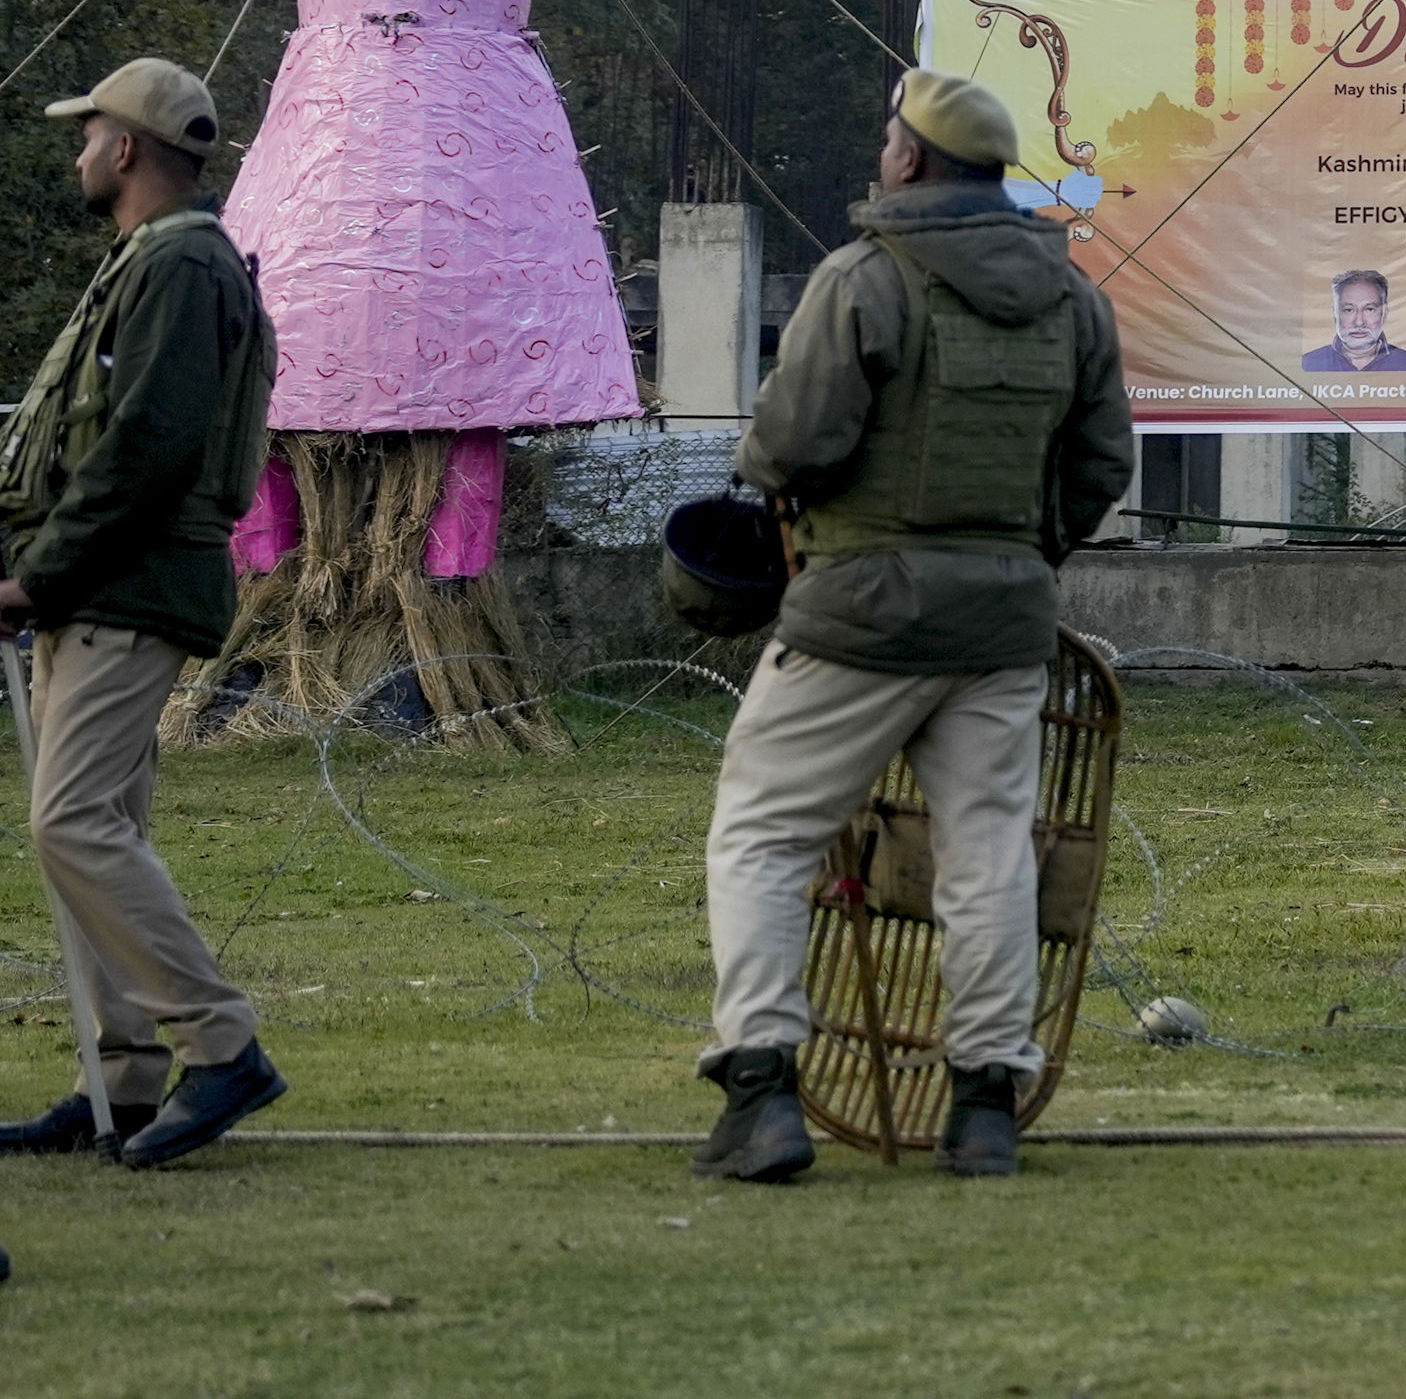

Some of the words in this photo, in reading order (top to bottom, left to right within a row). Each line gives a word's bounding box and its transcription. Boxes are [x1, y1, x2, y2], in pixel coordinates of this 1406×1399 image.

[1334, 83, 1364, 97] May
[1369, 82, 1398, 95] this
[1124, 386, 1184, 399] Venue:
[1188, 384, 1253, 399] Church
[1257, 385, 1303, 401] Lane,
[1312, 384, 1354, 398] IKCA
